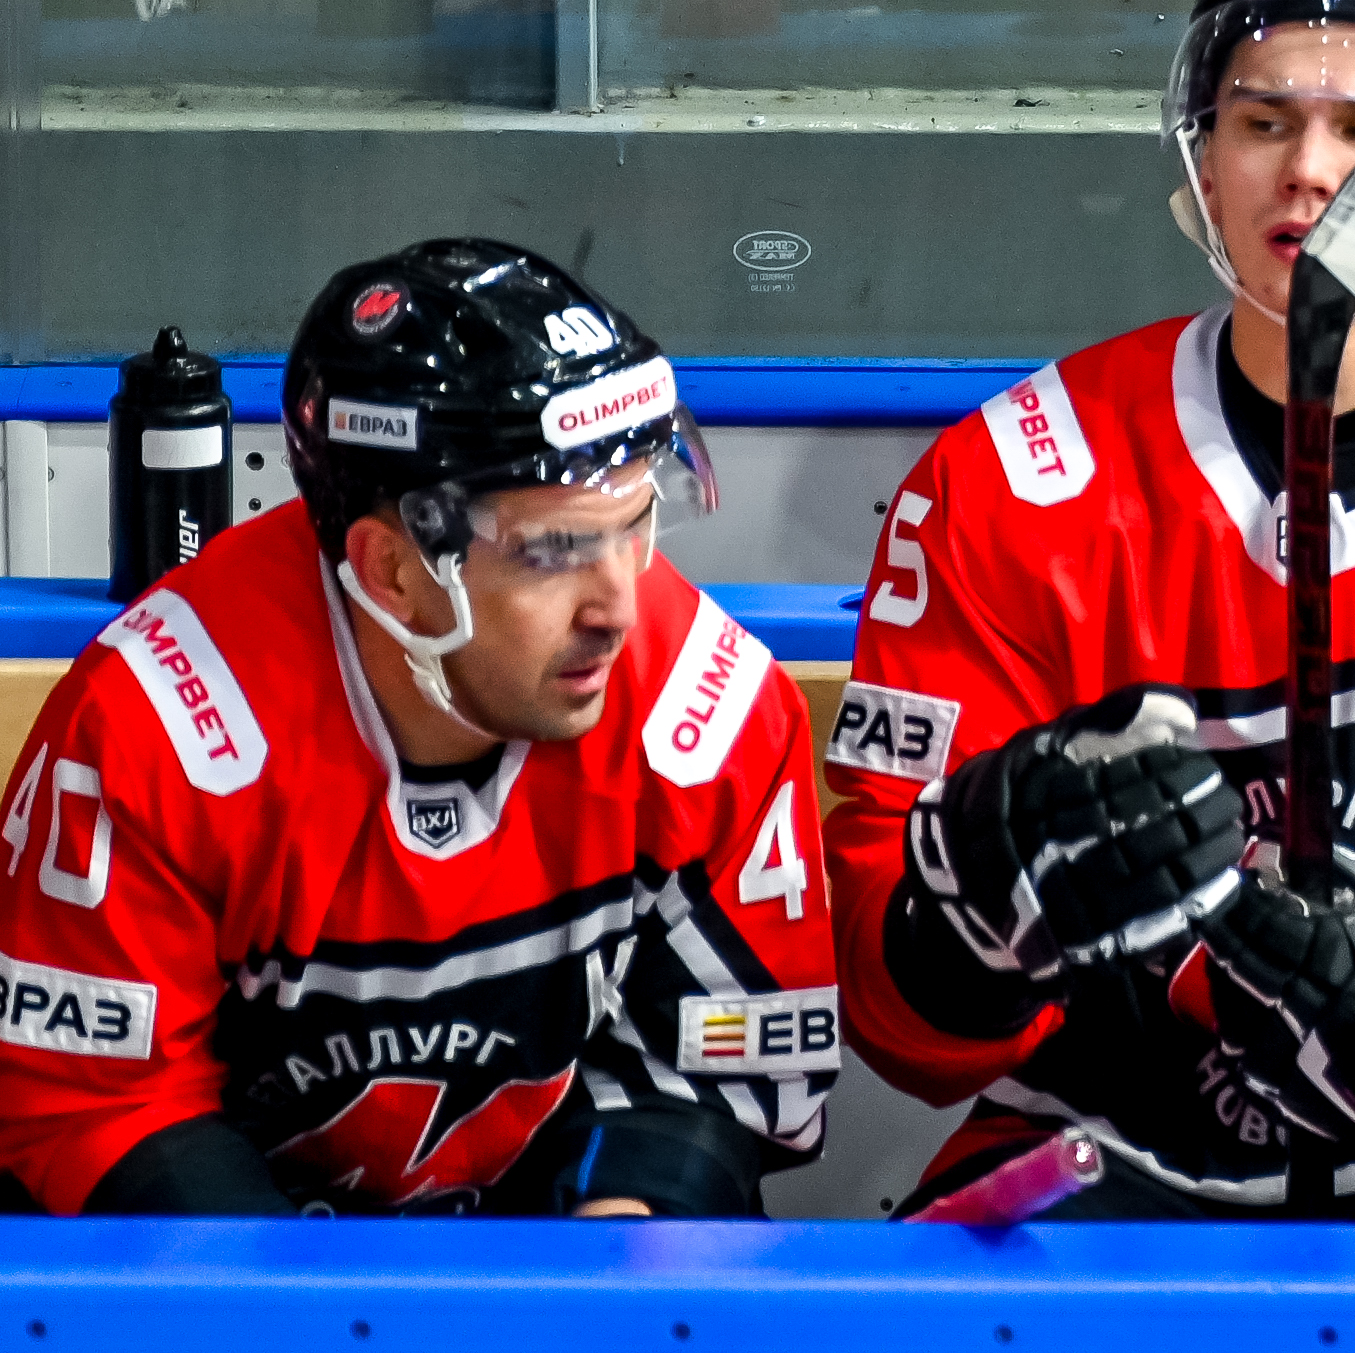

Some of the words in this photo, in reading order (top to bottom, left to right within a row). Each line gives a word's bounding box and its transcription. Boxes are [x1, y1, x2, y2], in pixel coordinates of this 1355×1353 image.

[543, 305, 614, 357] 40
[348, 412, 407, 438] ЕВРАЗ
[557, 375, 669, 432] OLIMPBET
[1, 741, 113, 910] 40
[0, 977, 133, 1043] РАЗ
